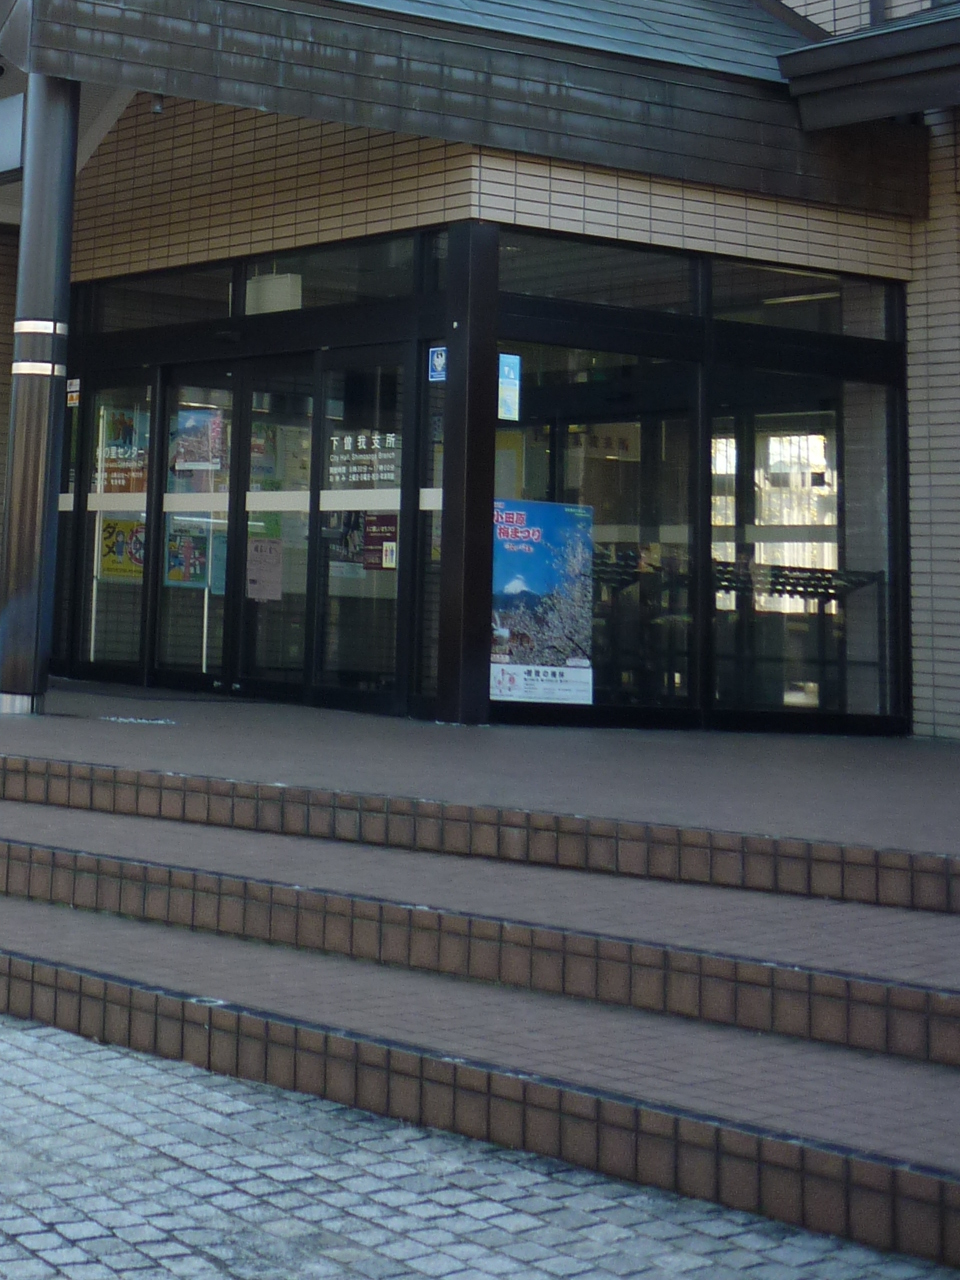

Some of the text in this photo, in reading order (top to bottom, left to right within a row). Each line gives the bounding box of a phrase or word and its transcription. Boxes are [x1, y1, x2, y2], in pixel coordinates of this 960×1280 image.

[330, 433, 396, 451] 下曽我支所
[494, 509, 526, 526] 小田原
[497, 525, 541, 542] 梅まつり
